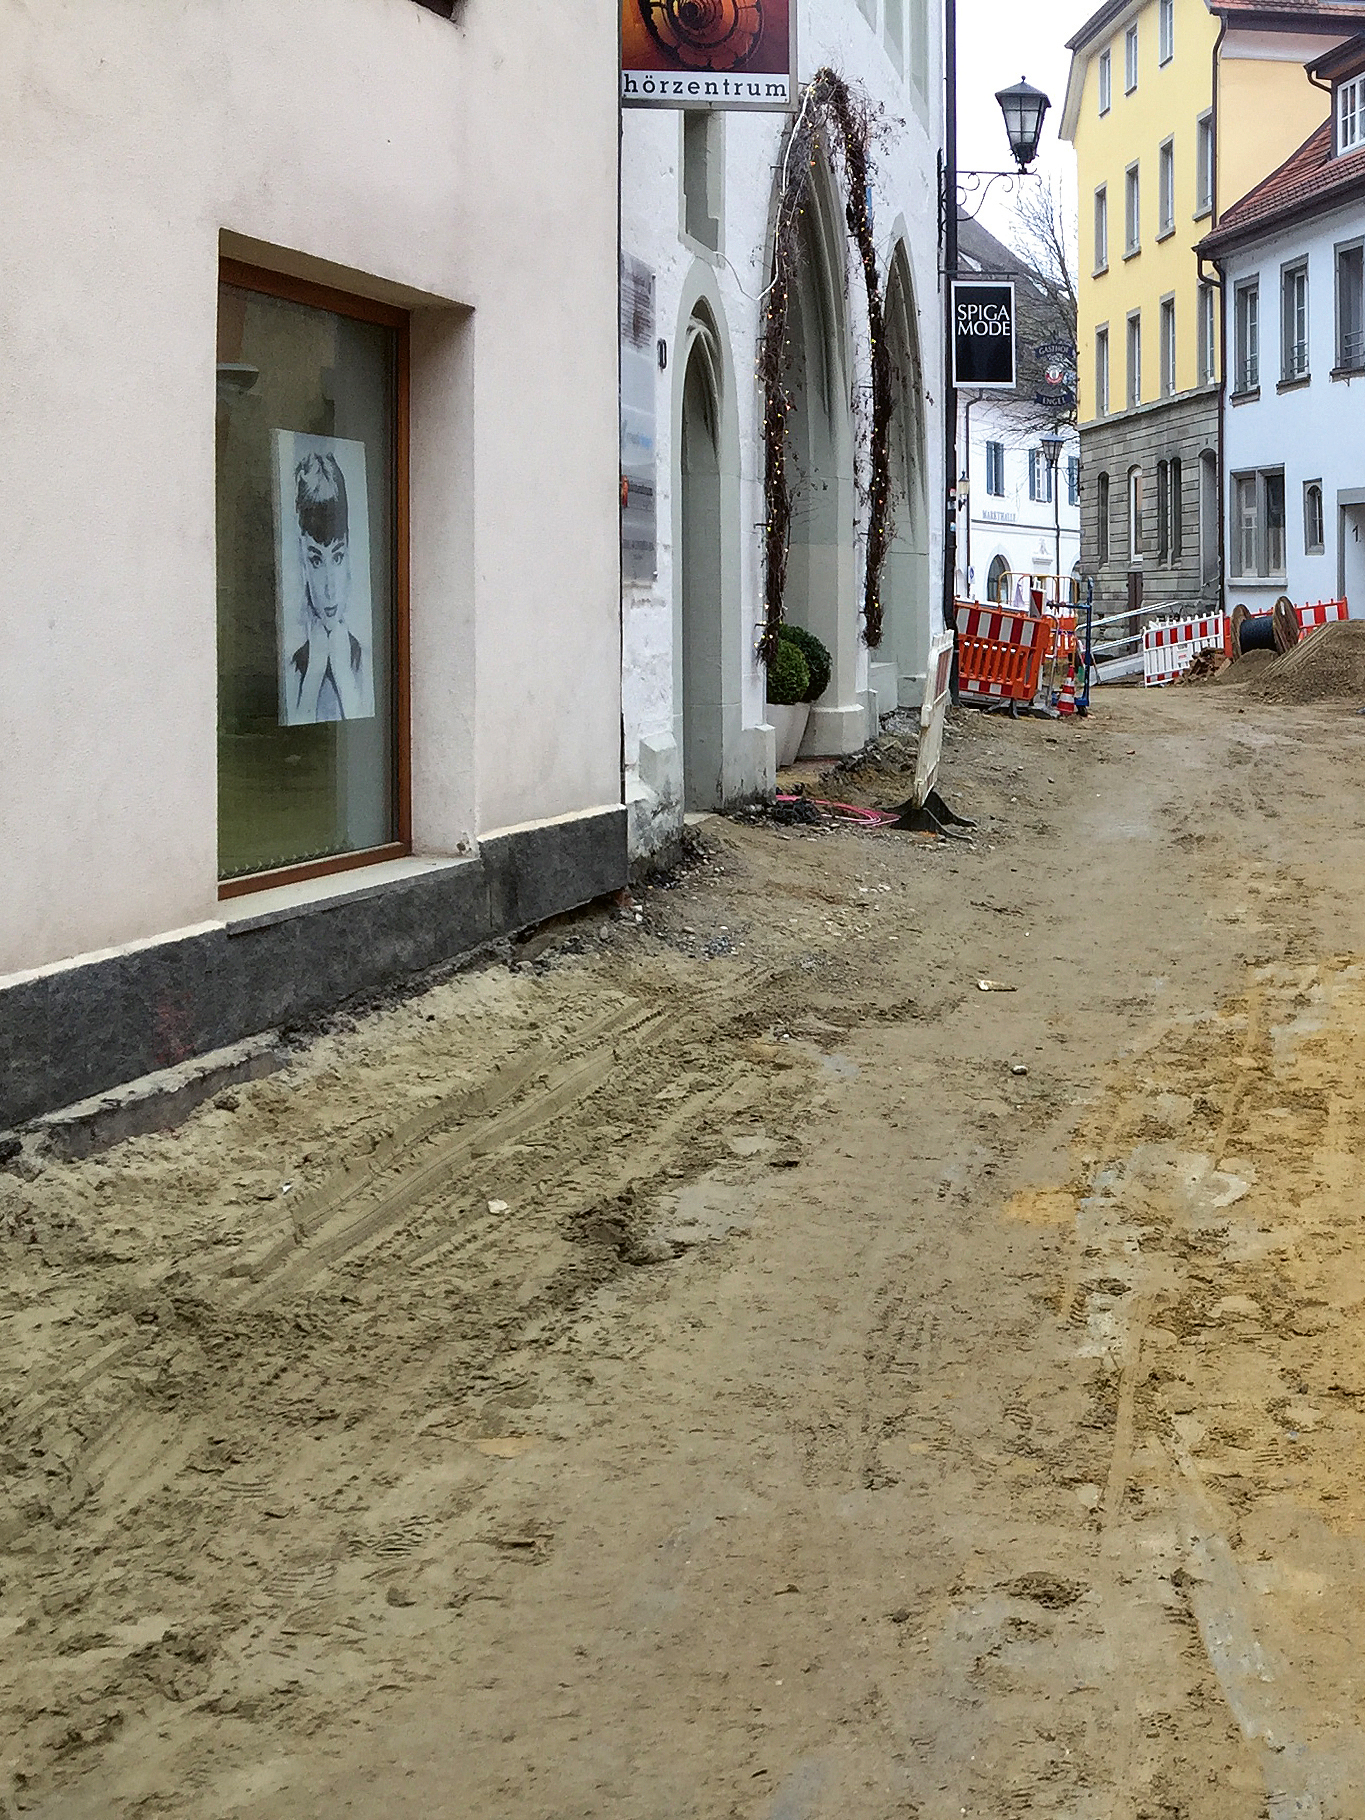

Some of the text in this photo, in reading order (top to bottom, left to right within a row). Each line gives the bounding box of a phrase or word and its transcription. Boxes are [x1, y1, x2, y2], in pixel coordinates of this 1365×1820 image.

[624, 74, 787, 96] hörzentrum
[957, 304, 1010, 321] SPIGA
[957, 321, 1011, 336] MODE
[1038, 346, 1070, 355] GASTHOF
[1042, 396, 1066, 405] ENGEL
[982, 509, 1016, 522] MARKTHALLE
